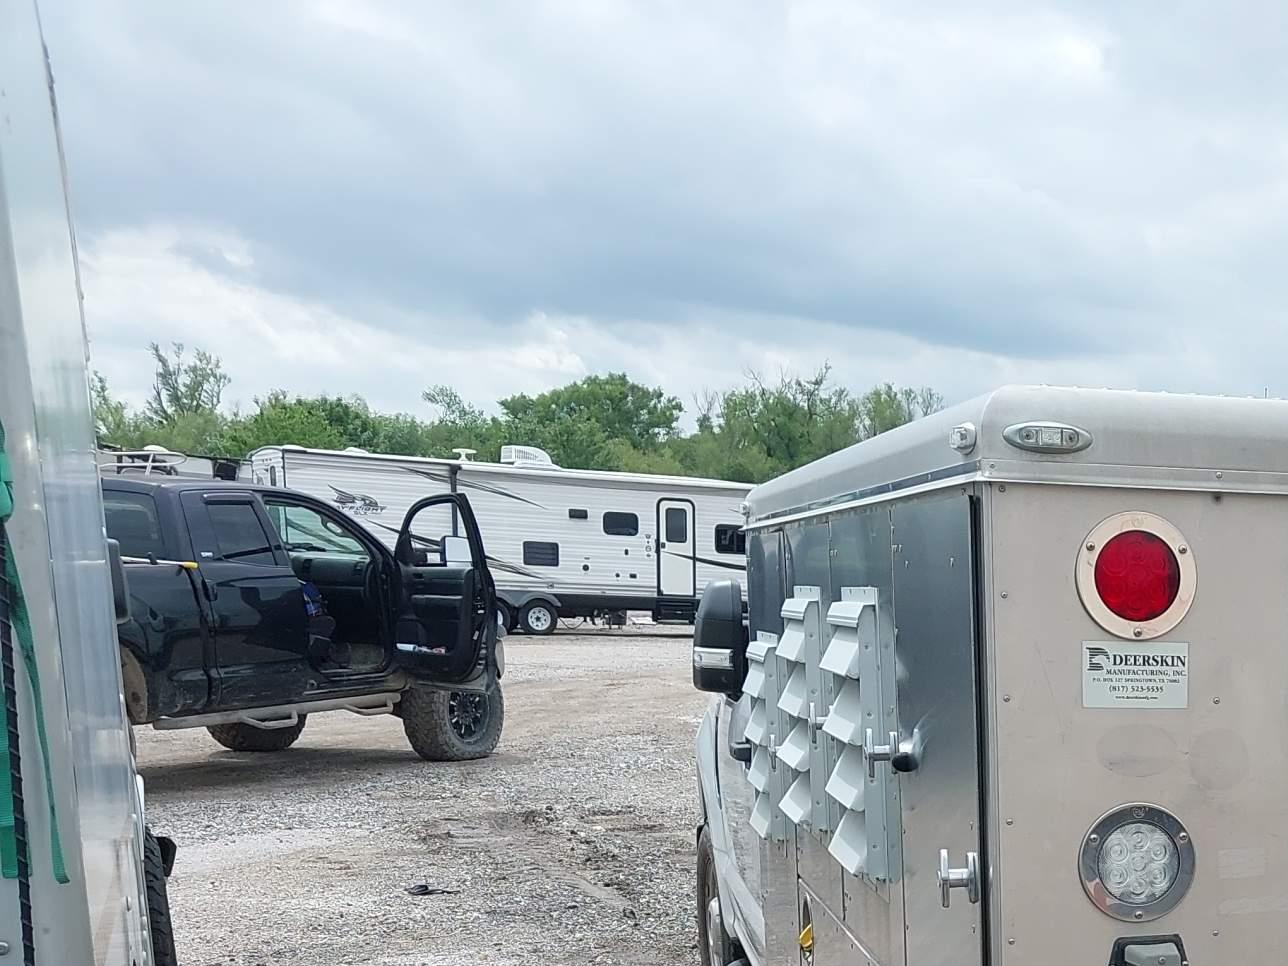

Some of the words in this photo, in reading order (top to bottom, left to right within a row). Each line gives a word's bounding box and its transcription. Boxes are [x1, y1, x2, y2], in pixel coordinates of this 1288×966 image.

[1112, 654, 1187, 668] DEERSKIN
[1105, 669, 1170, 677] MANUFACTURING,
[1172, 669, 1187, 677] INC.
[1108, 685, 1129, 693] (817)
[1131, 685, 1164, 693] 523-5535
